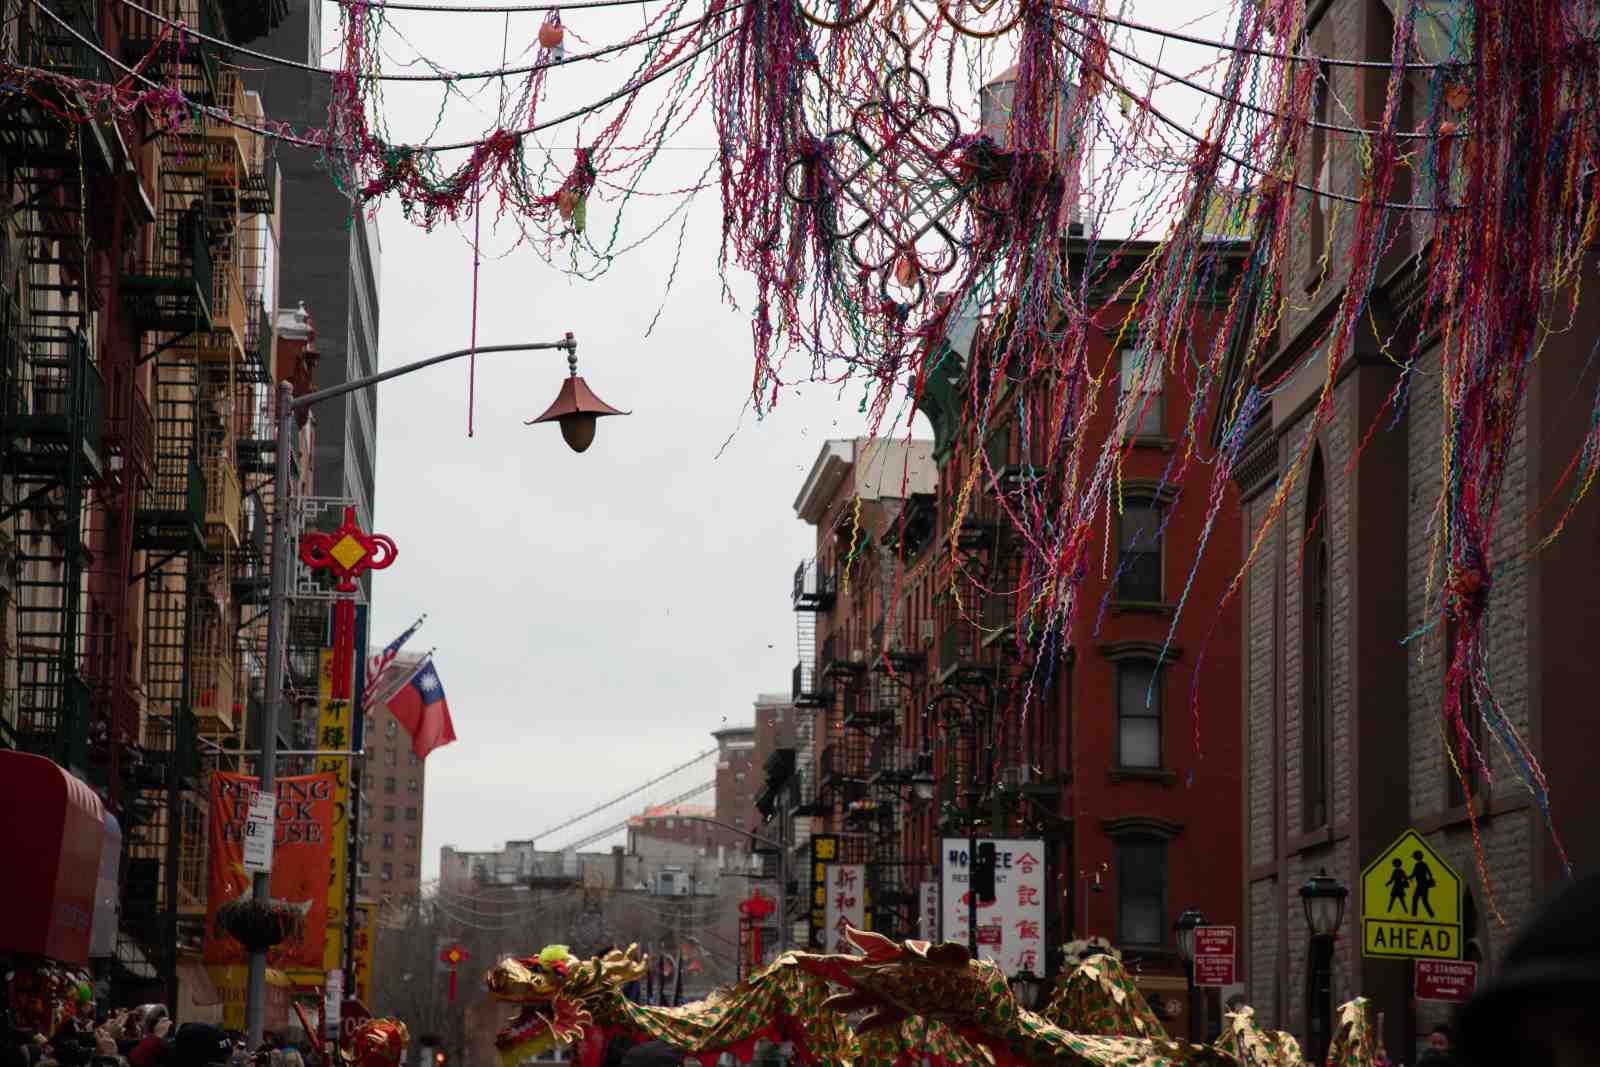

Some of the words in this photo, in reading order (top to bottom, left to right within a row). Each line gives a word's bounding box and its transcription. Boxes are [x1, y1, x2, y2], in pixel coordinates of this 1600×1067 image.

[233, 800, 316, 822] DCK
[223, 821, 321, 845] HUSE
[948, 850, 970, 868] HO
[1373, 926, 1451, 952] AHEAD
